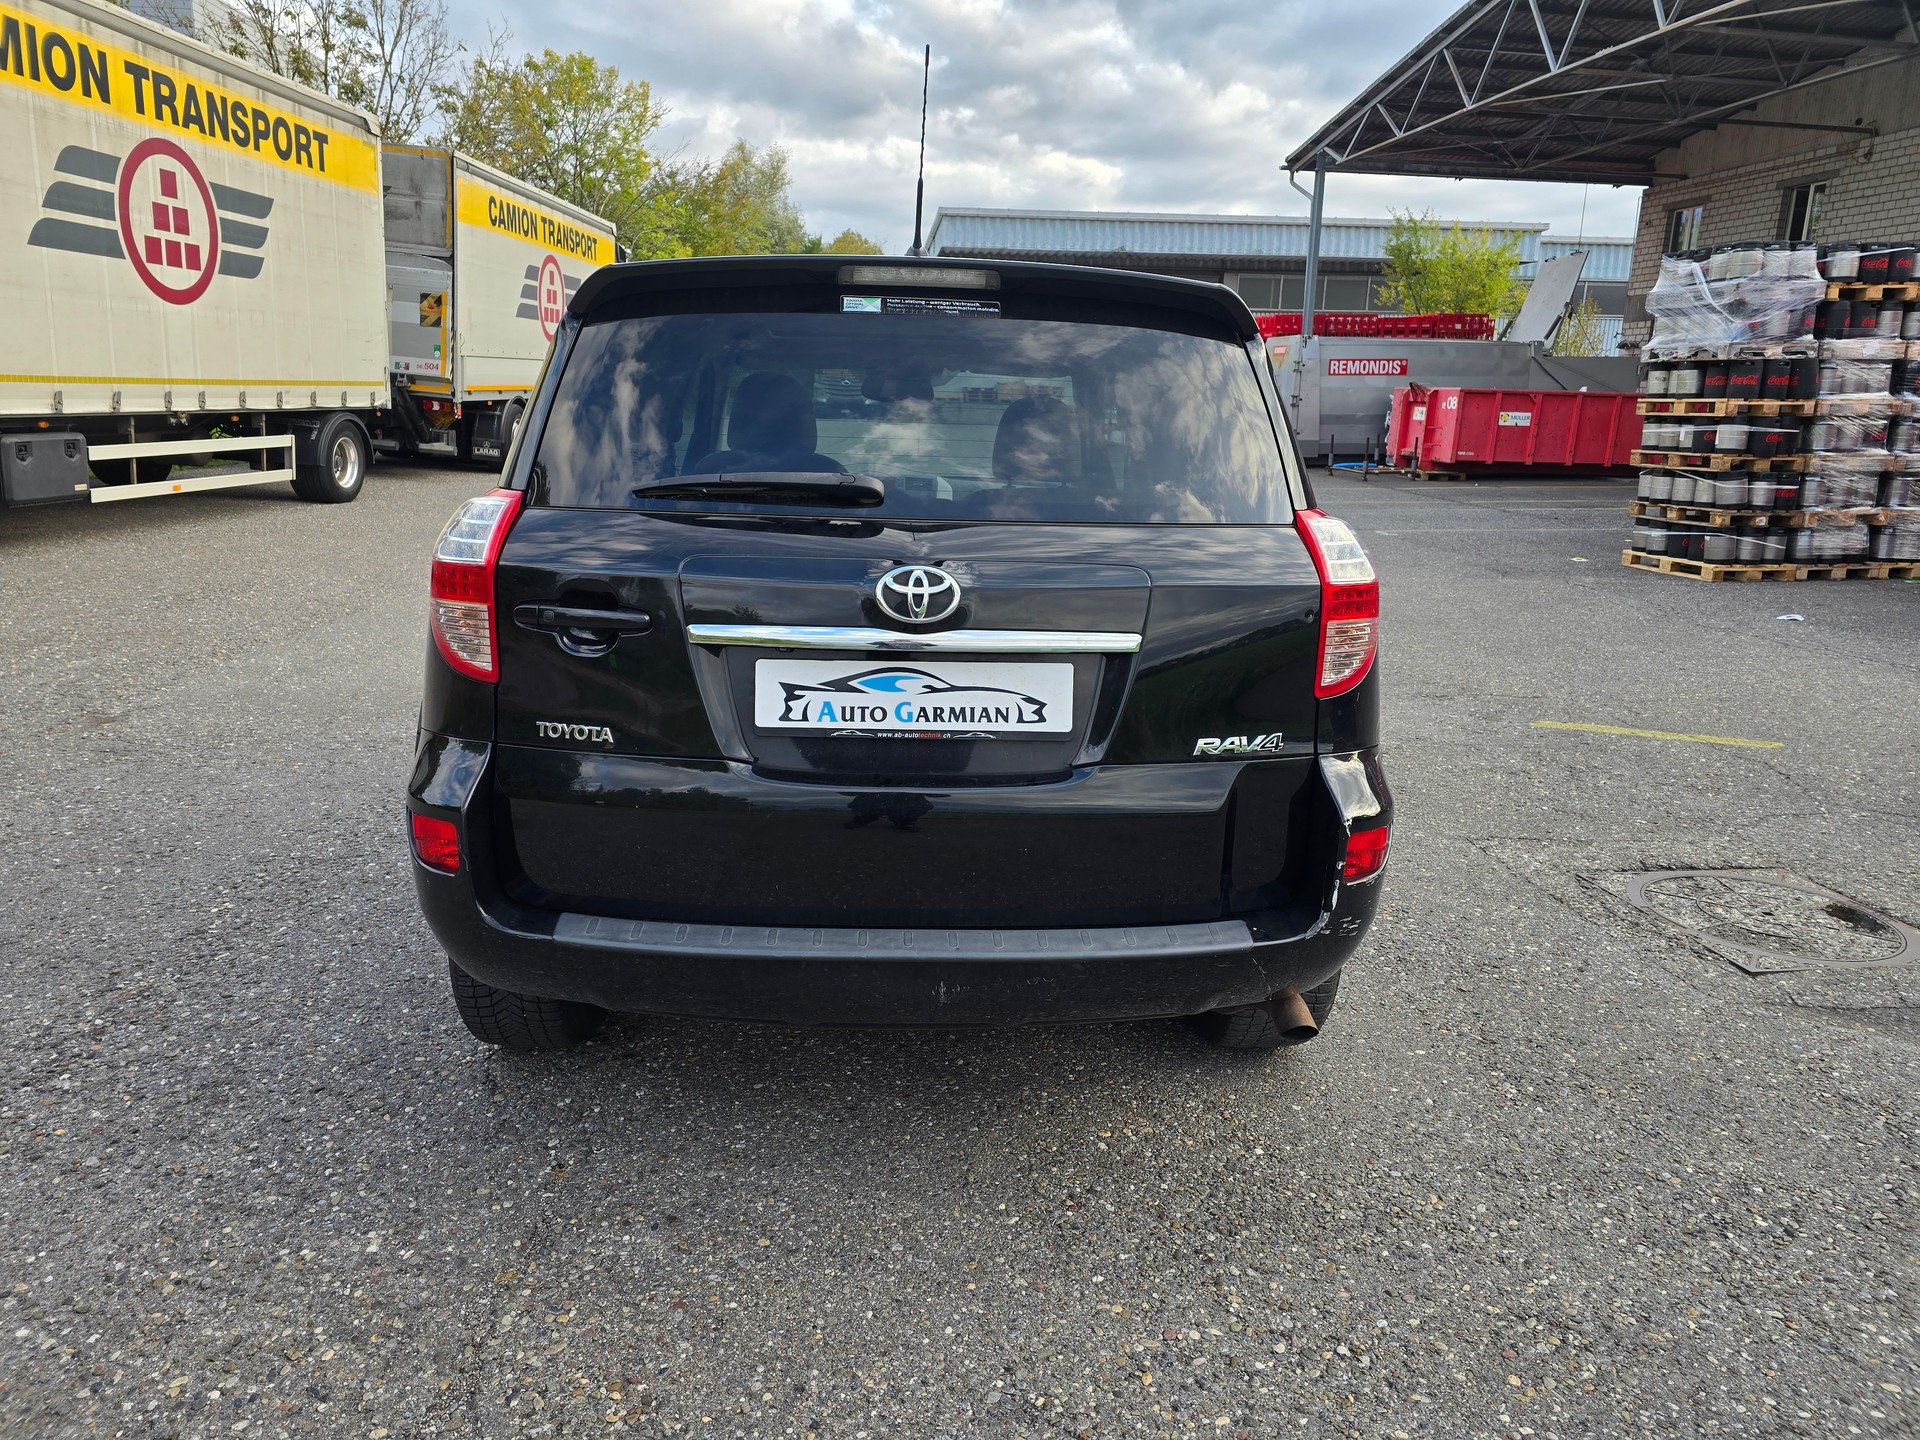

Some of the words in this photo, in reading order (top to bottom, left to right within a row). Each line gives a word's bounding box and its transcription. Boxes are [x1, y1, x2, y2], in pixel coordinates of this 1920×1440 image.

[123, 59, 329, 173] TRANSPORT
[488, 195, 538, 241] CAMION
[540, 215, 598, 262] TRANSPORT
[536, 721, 614, 743] TOYOTA
[1193, 732, 1284, 756] RAV4
